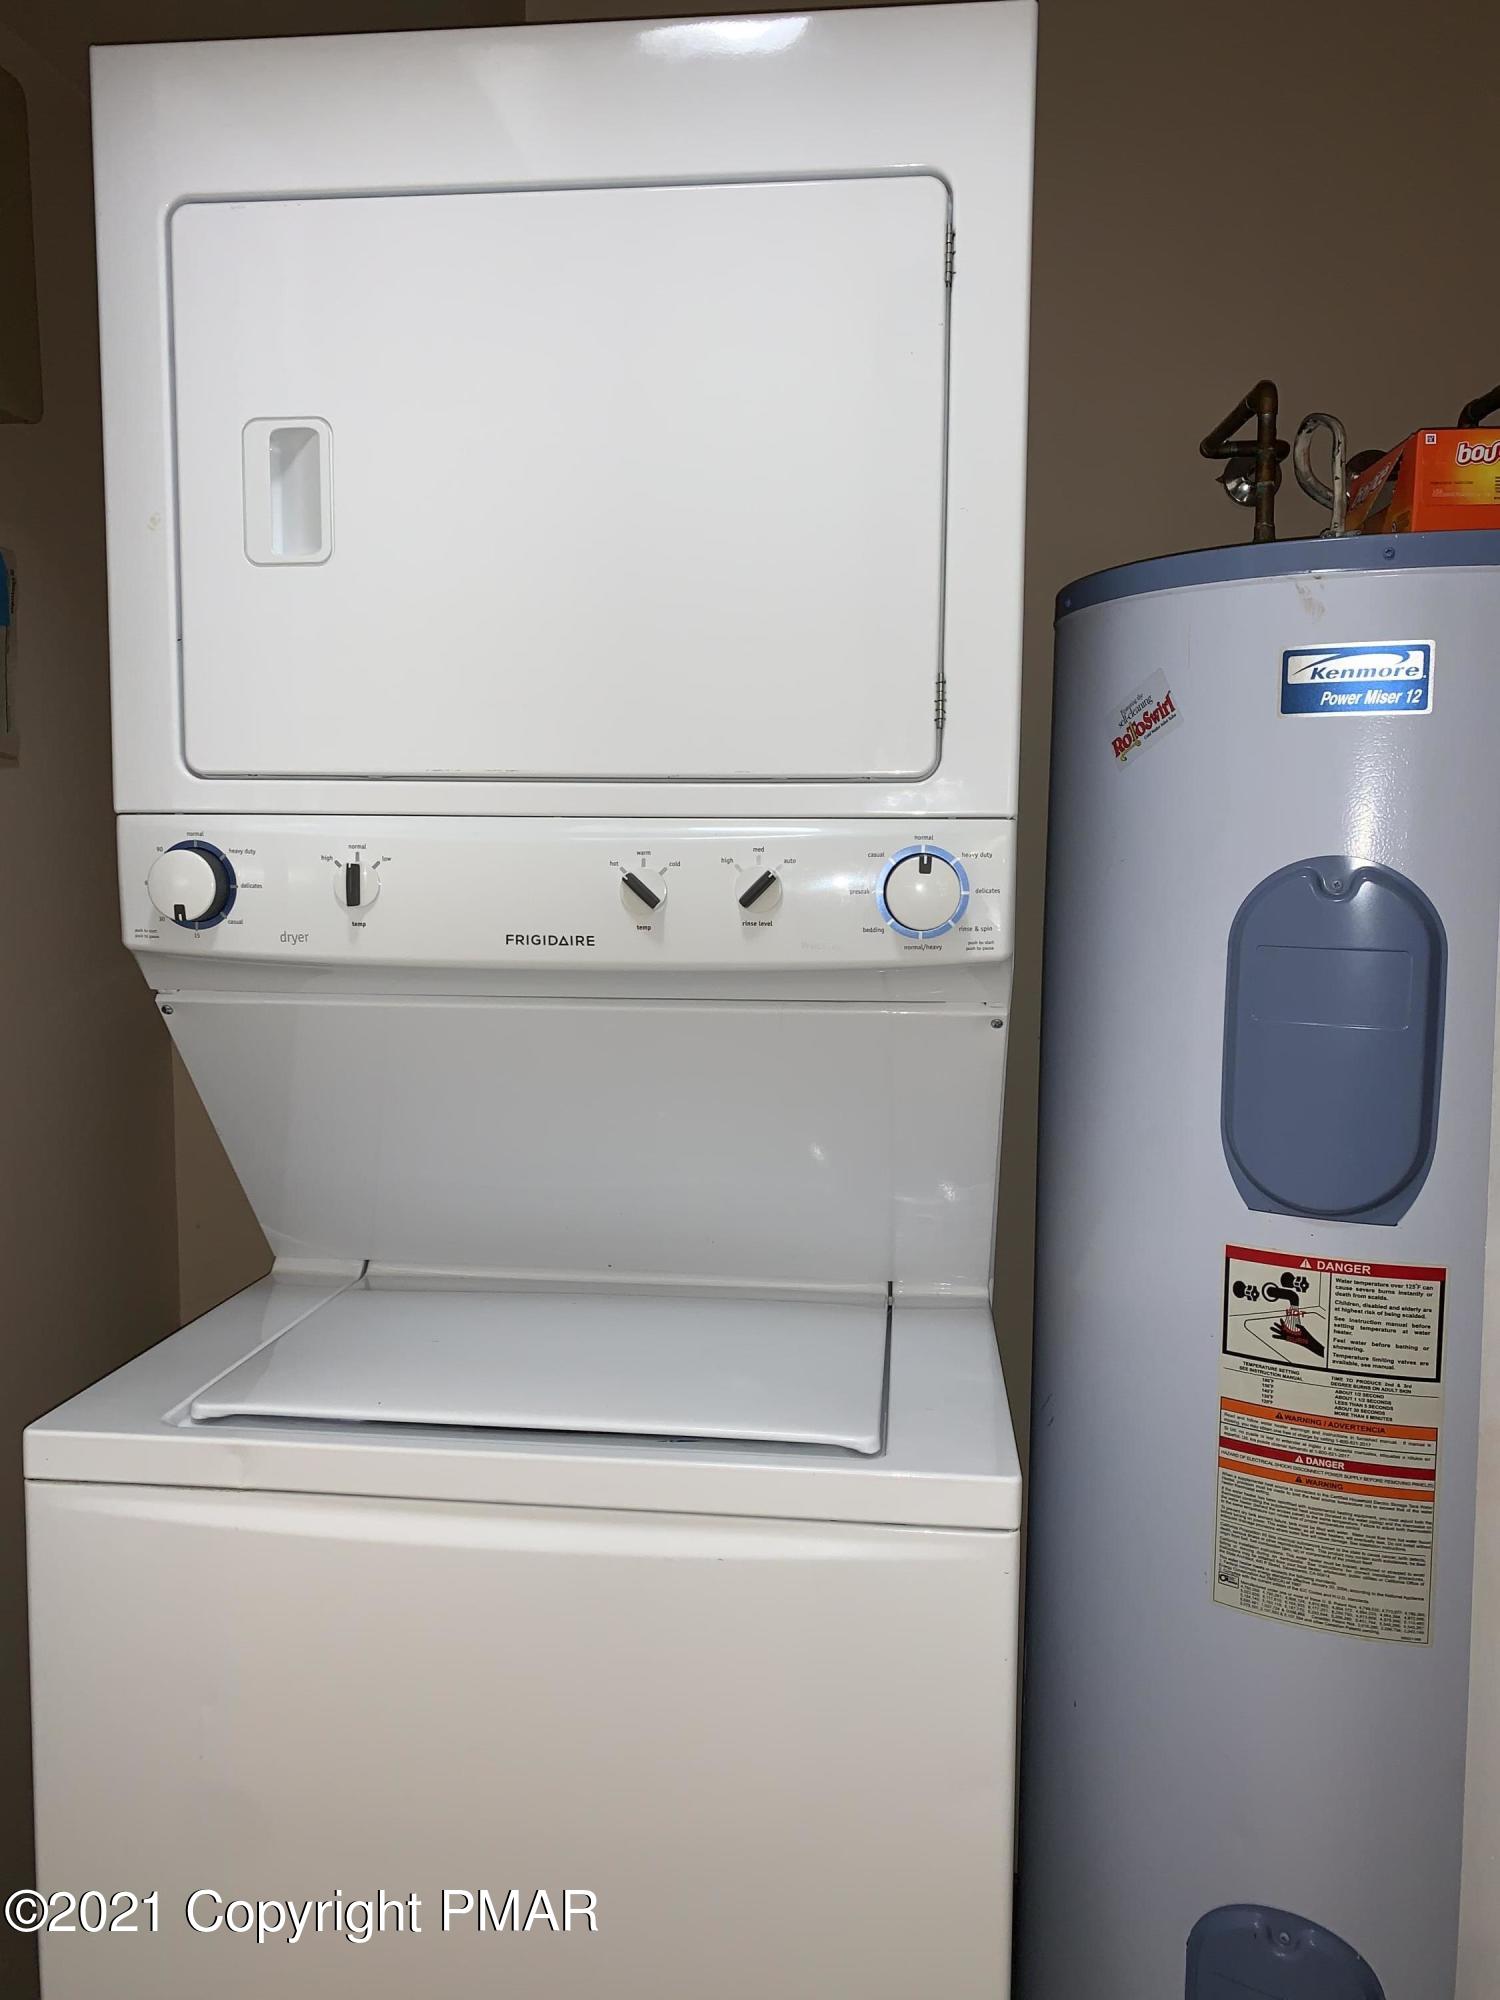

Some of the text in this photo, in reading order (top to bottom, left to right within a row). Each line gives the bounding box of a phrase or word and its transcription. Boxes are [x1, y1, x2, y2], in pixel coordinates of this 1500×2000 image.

[1310, 666, 1420, 680] Kenmore
[1320, 688, 1422, 706] Power Miser 12
[280, 930, 309, 945] dryer
[505, 934, 596, 947] FRIGIDAIRE
[1316, 1260, 1371, 1275] DANGER
[1284, 1414, 1321, 1426] WARNING
[1328, 1422, 1386, 1433] ADVERTENCIA
[1306, 1459, 1345, 1470] DANGER
[1305, 1478, 1343, 1490] WARNING
